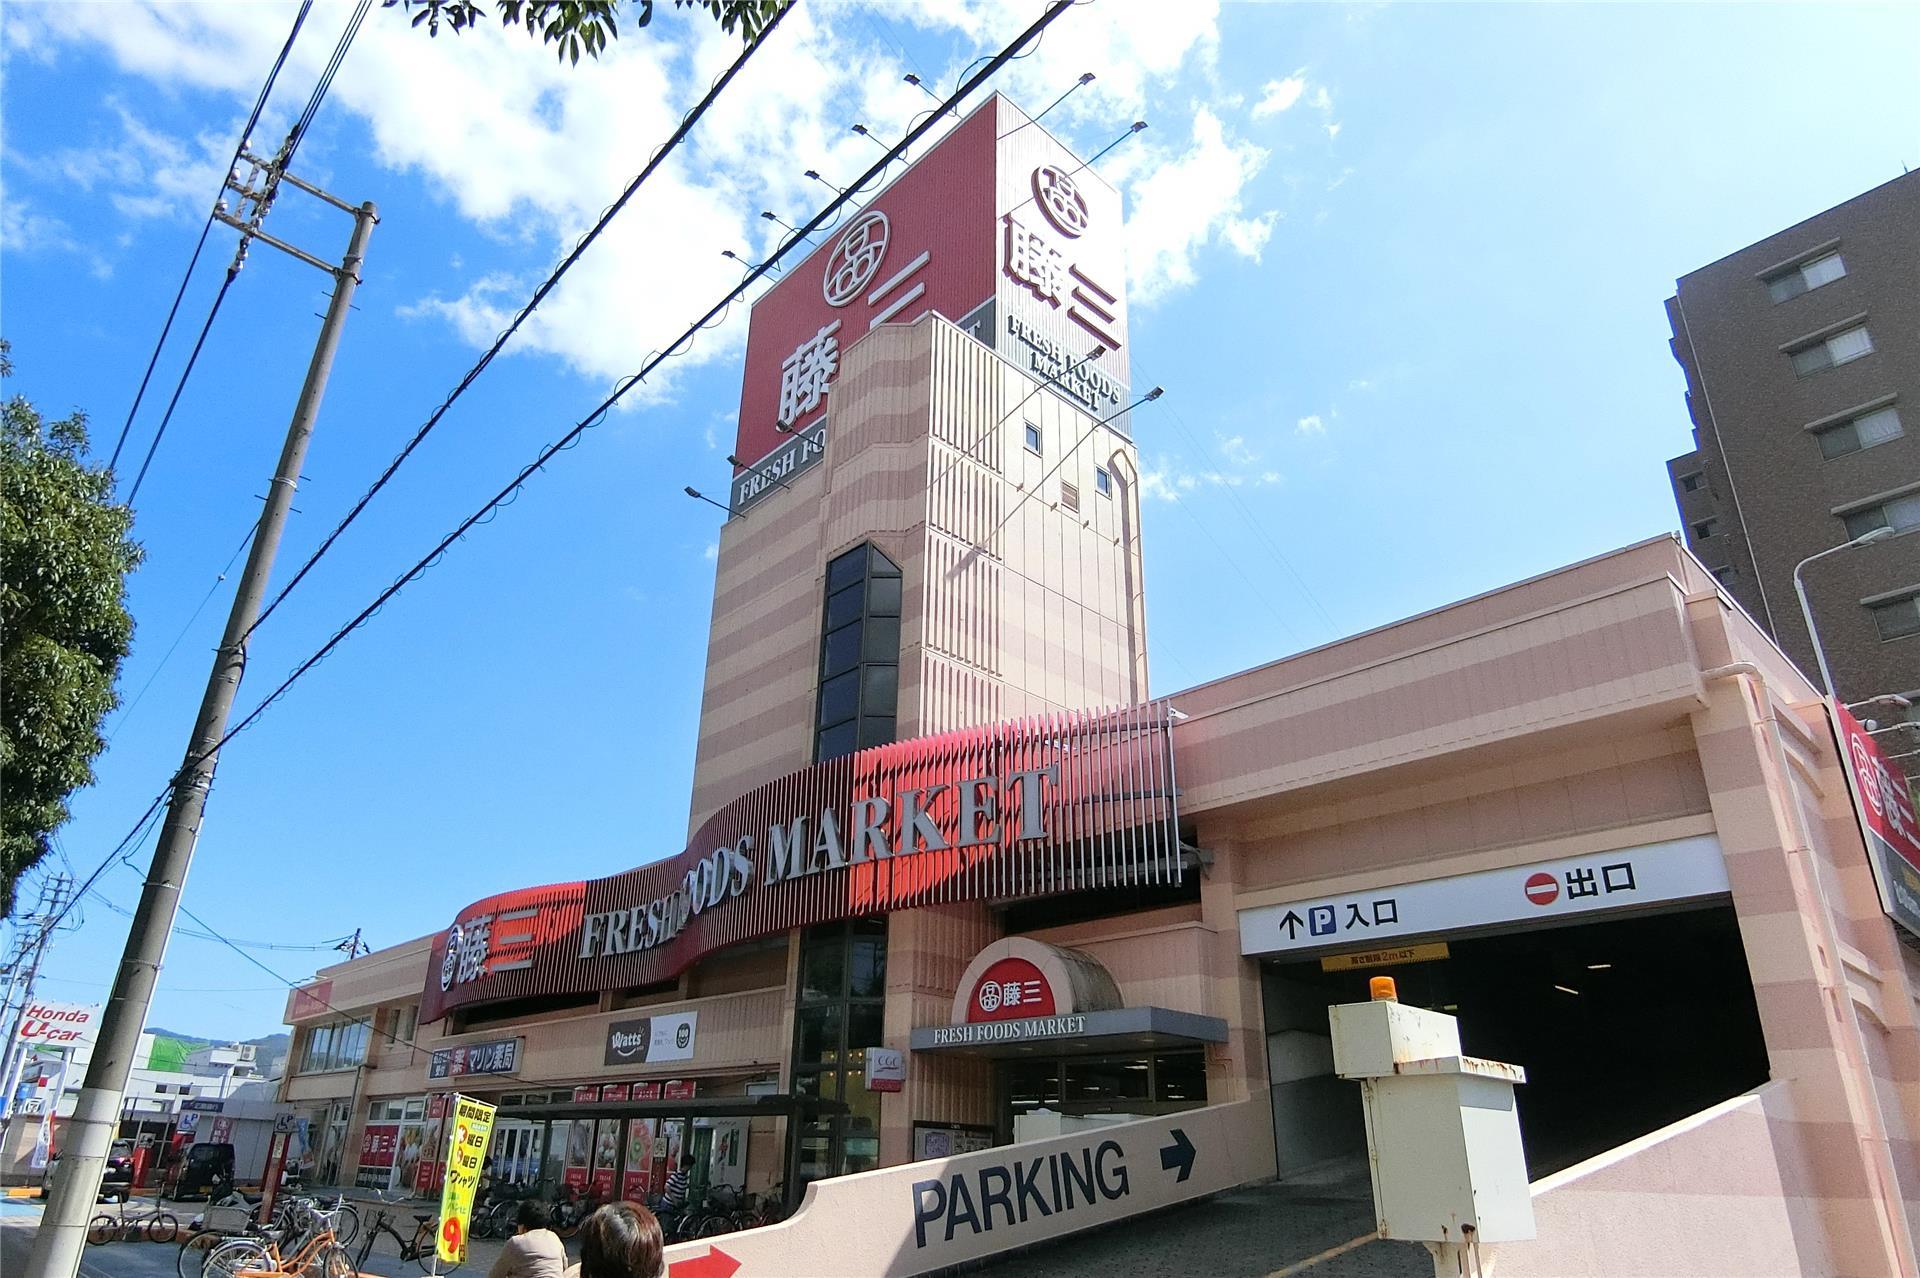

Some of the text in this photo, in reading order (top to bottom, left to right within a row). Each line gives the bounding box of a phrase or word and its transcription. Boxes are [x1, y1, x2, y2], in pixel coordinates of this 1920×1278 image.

[1007, 315, 1121, 405] FRESH FOODS
[1029, 350, 1100, 412] MARKET
[738, 448, 796, 506] FRESH
[578, 891, 683, 959] FRESH
[763, 765, 1058, 887] MARKET
[1565, 862, 1636, 900] 出口
[1345, 899, 1398, 930] 入口
[457, 907, 539, 984] 藤三
[1003, 980, 1042, 1006] 藤三
[26, 1005, 90, 1023] Honda
[934, 1016, 1086, 1043] FRESH FOODS MARKET
[20, 1020, 84, 1041] U-car
[612, 1031, 642, 1048] Watts
[470, 1043, 514, 1071] マリン薬局
[459, 1104, 492, 1123] 期間限定
[912, 1140, 1130, 1249] PARKING
